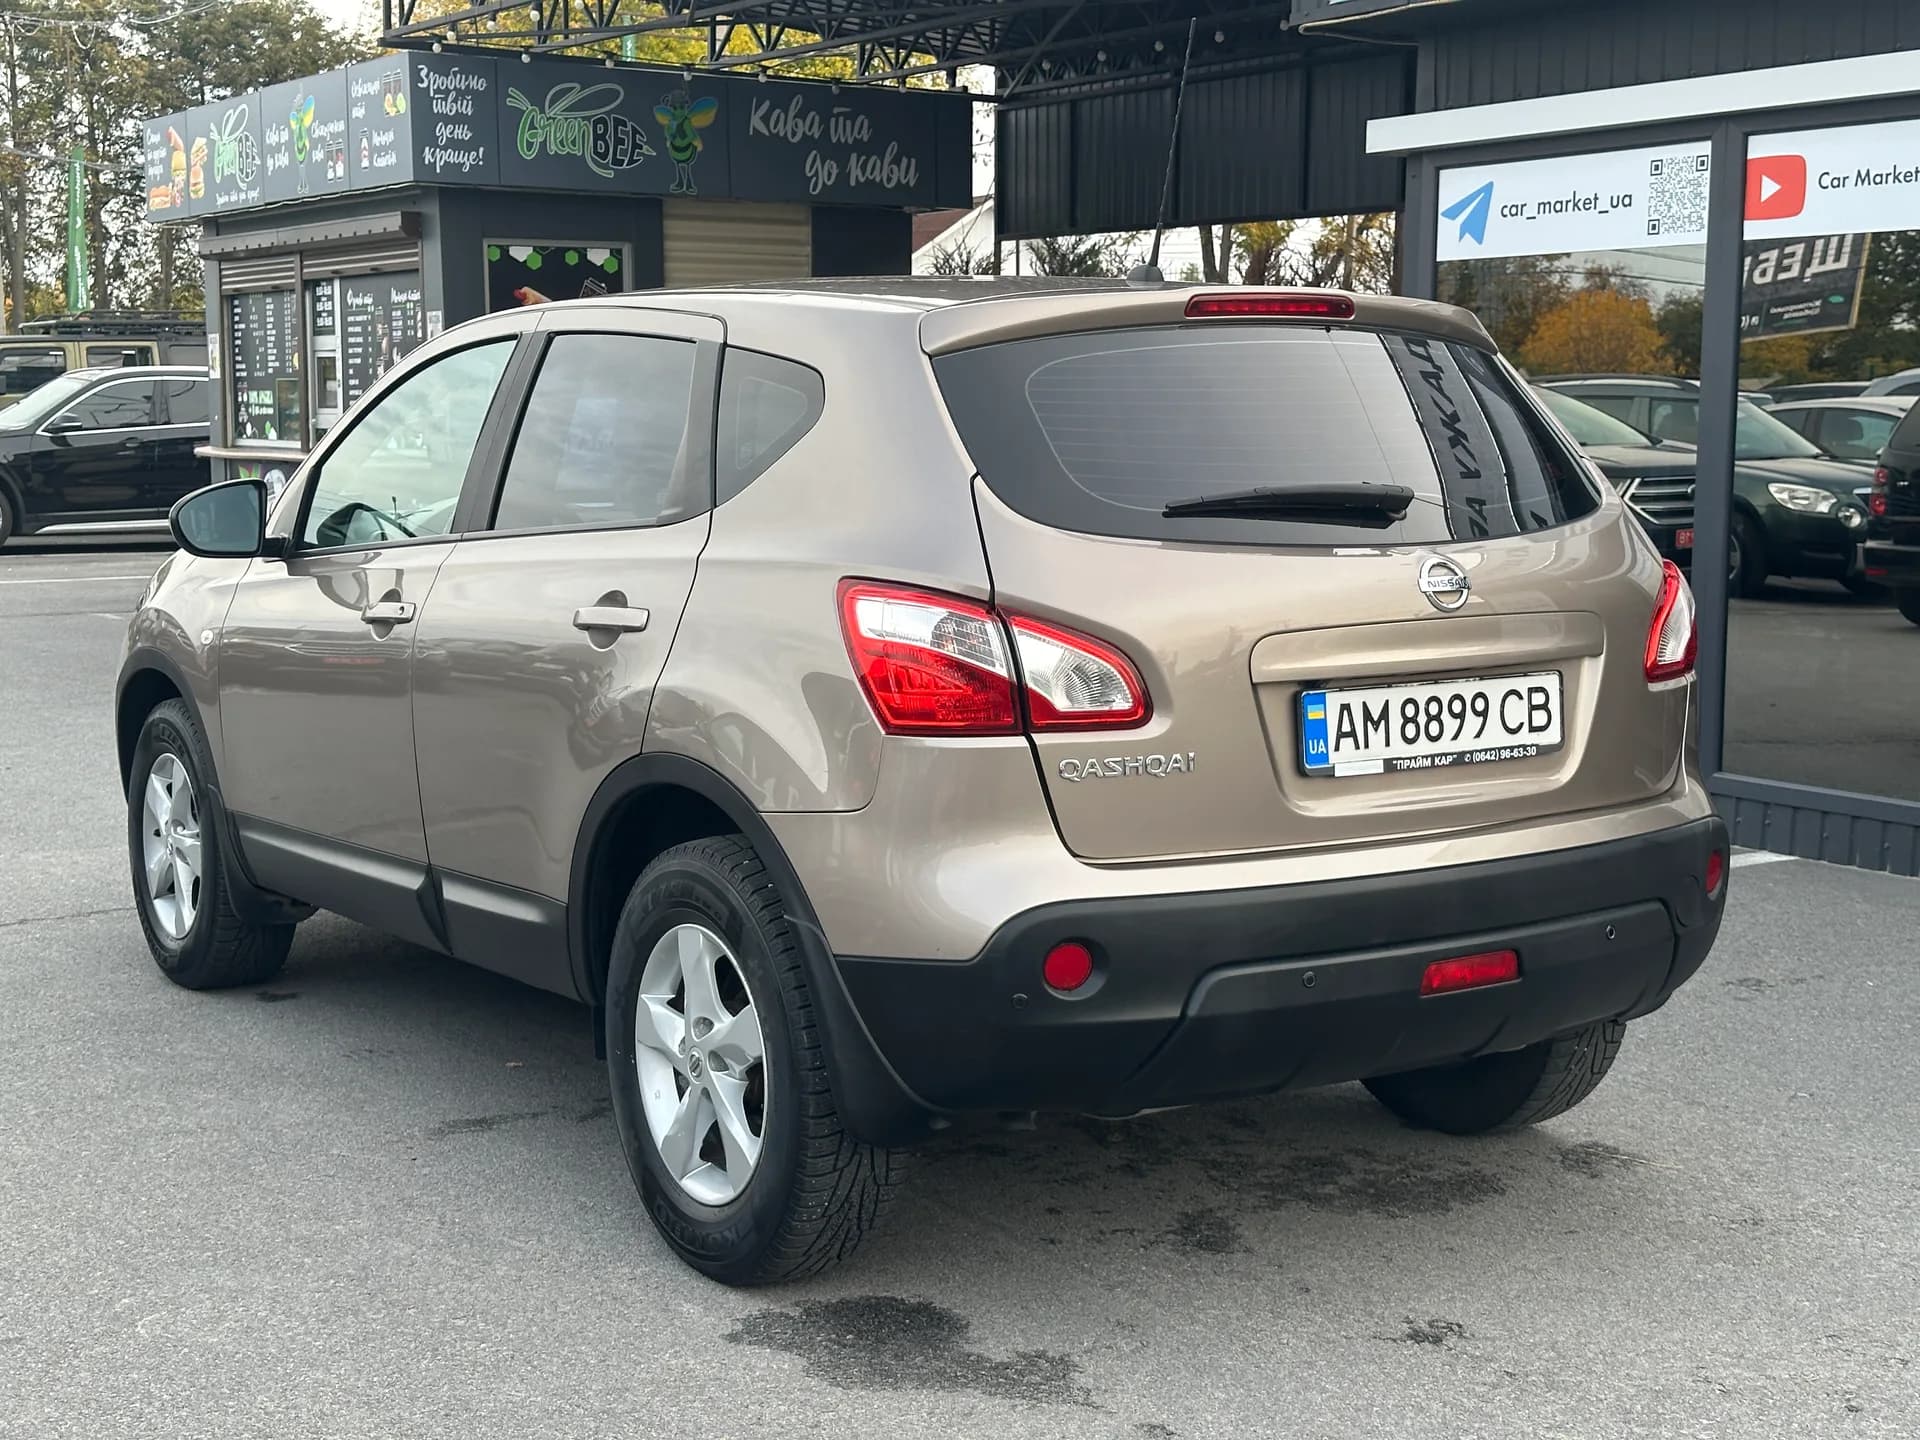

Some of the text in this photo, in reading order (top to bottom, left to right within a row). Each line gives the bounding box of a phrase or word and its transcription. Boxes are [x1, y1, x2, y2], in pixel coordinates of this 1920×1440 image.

[417, 65, 487, 96] Зробимо
[432, 92, 473, 116] твій
[750, 94, 872, 144] Кава та
[435, 121, 472, 146] день
[423, 147, 484, 173] краще!
[805, 141, 919, 195] до кави
[1818, 164, 1920, 190] Car Market
[1500, 188, 1633, 219] car_market_ua
[1427, 577, 1469, 588] NISSAN
[1333, 686, 1552, 752] AM 8899 CB
[1309, 739, 1327, 754] UA
